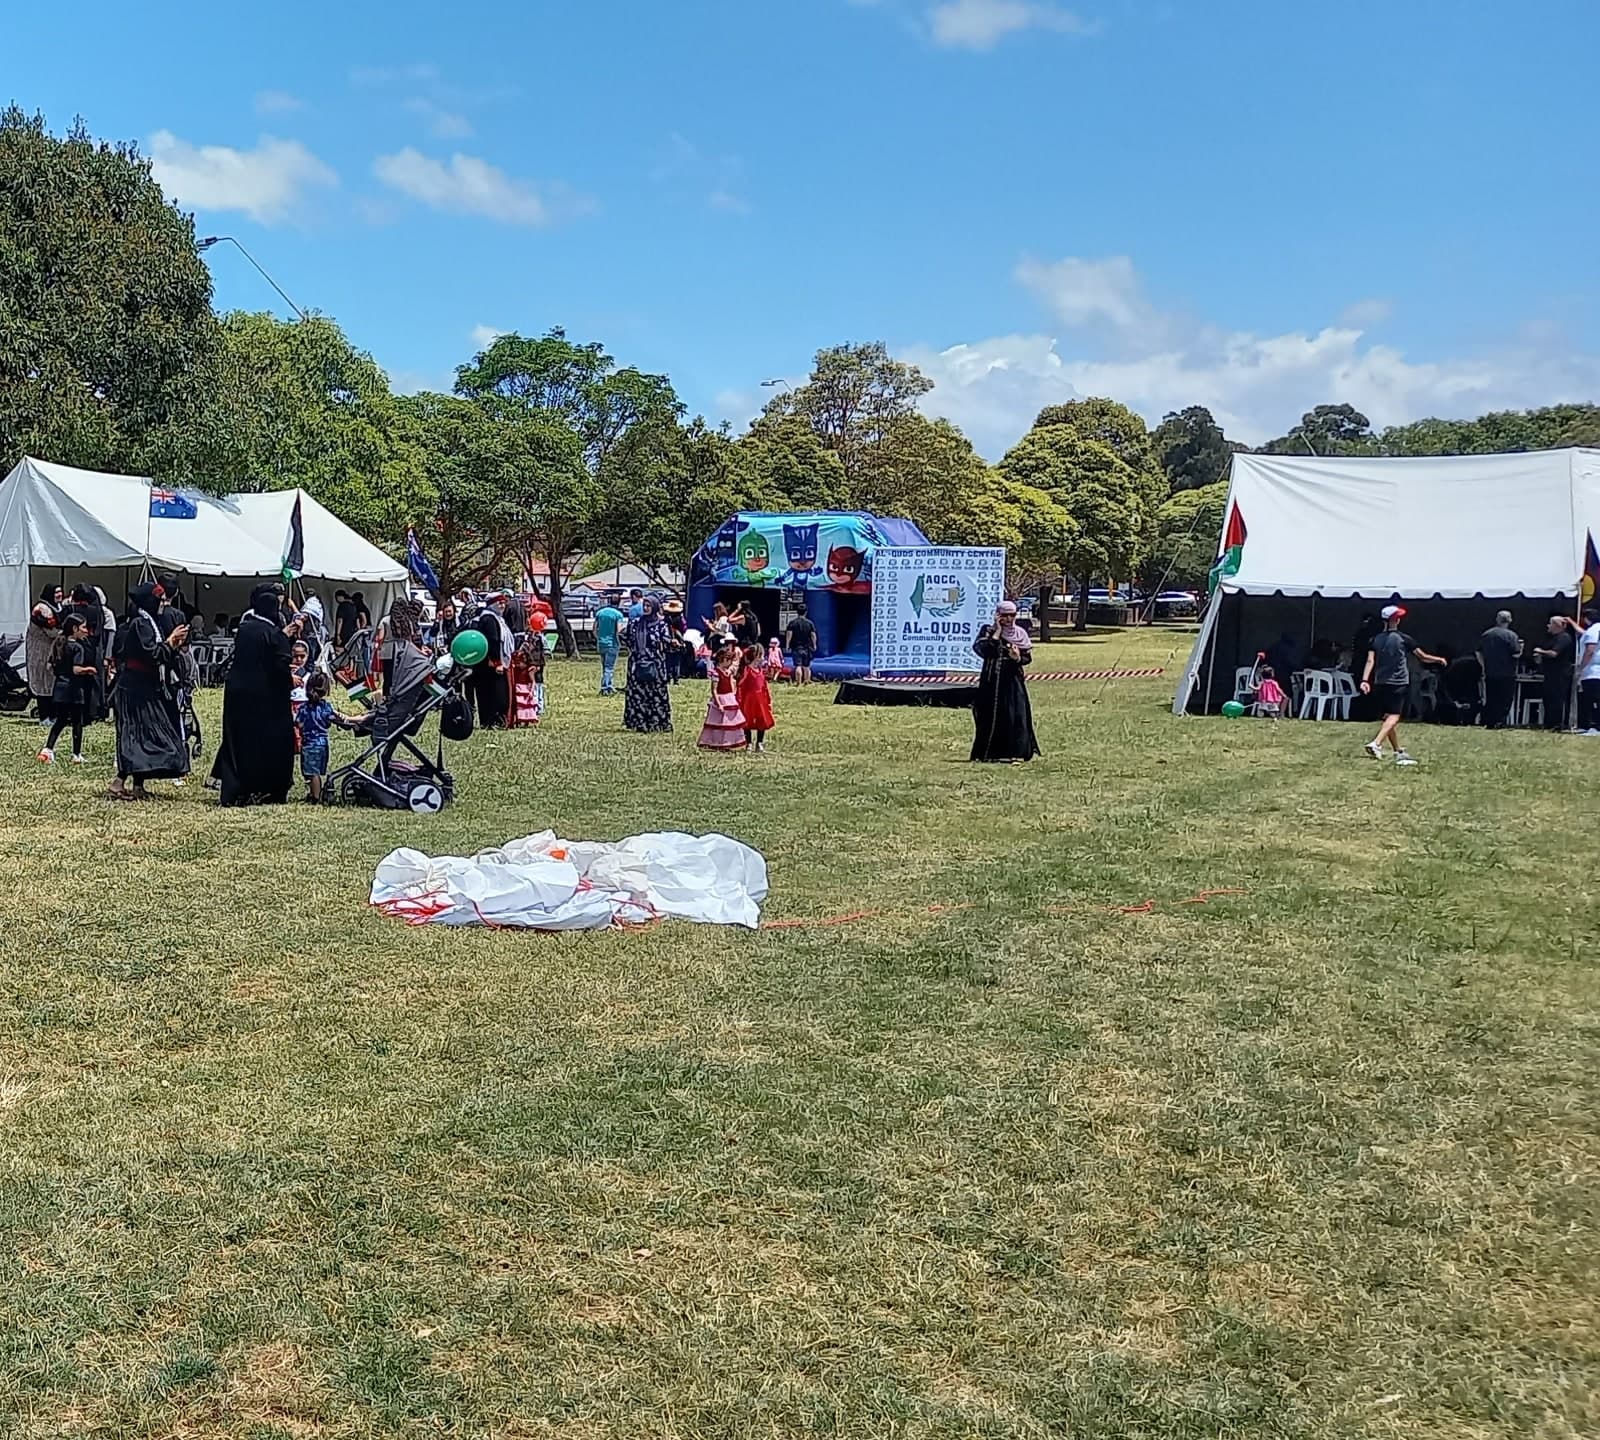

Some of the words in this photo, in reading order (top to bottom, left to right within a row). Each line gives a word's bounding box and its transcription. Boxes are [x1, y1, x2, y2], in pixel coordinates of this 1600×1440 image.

[916, 549, 965, 557] COMMUNITY
[926, 575, 956, 584] AQCC
[902, 621, 971, 634] AL-QUDS
[902, 634, 946, 643] Community
